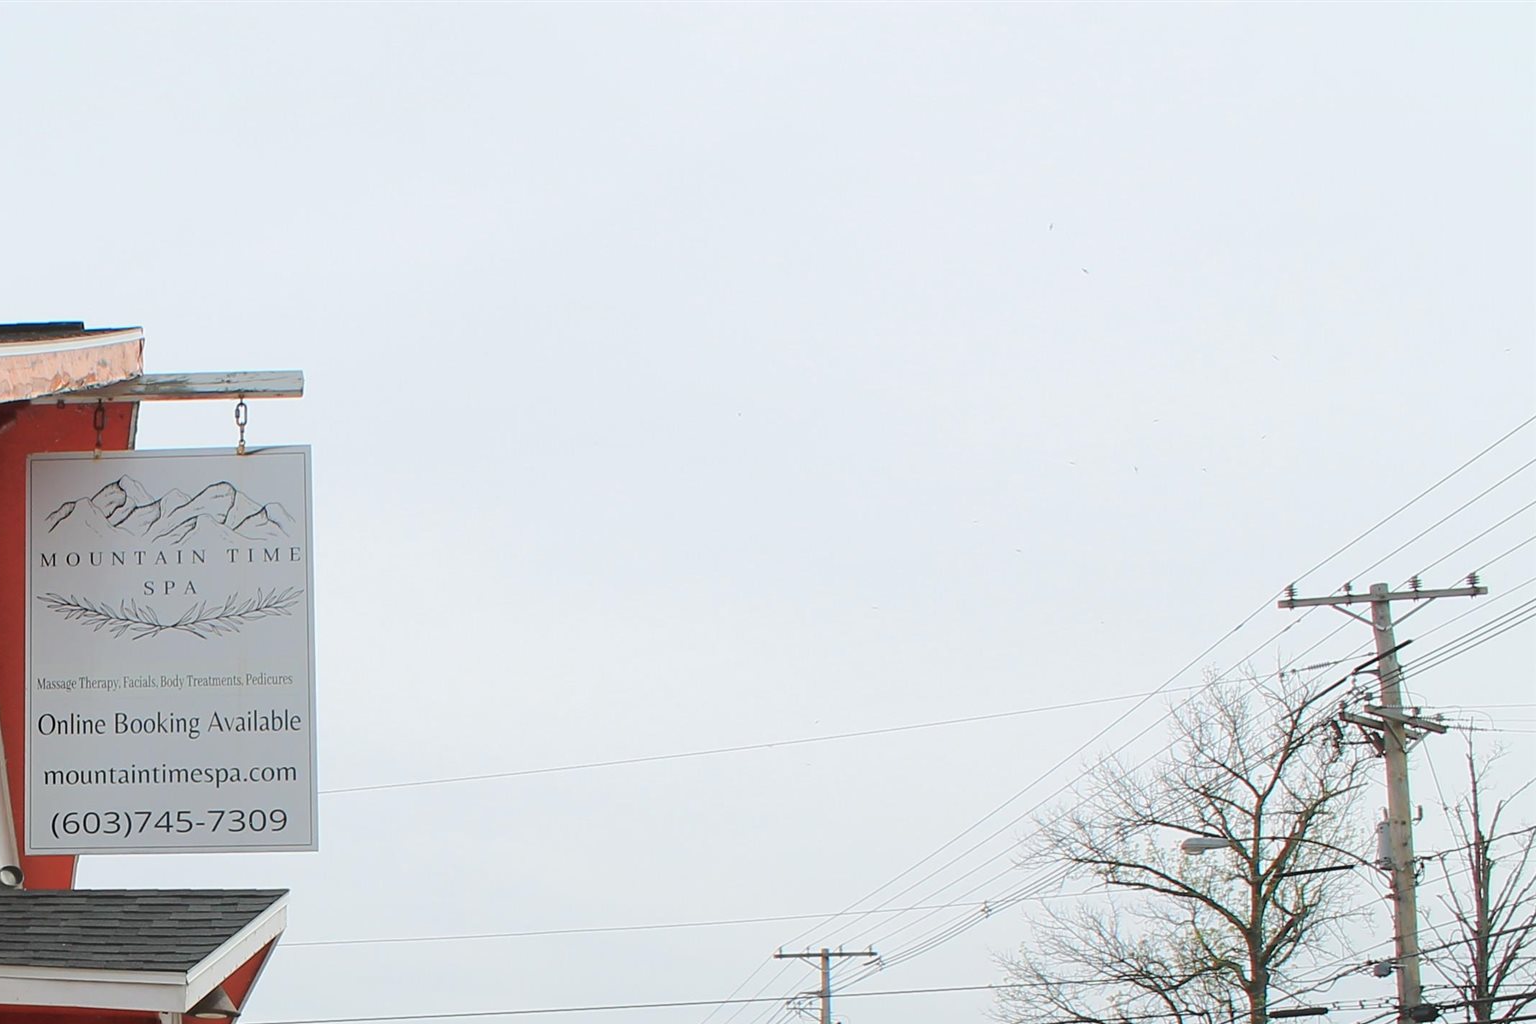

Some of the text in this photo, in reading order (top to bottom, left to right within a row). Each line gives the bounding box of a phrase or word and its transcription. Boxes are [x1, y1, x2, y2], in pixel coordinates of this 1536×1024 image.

[40, 546, 302, 568] MOUNTAIN TIME
[143, 579, 199, 597] SPA
[36, 677, 77, 691] Massage
[78, 676, 121, 692] Therapy,
[160, 675, 185, 690] Body
[186, 674, 244, 688] Treatments,
[245, 673, 294, 686] Pedicures
[37, 709, 302, 740] Online Booking Available
[43, 763, 298, 789] mountaintimespa.com
[50, 808, 289, 841] (603)745-7309
